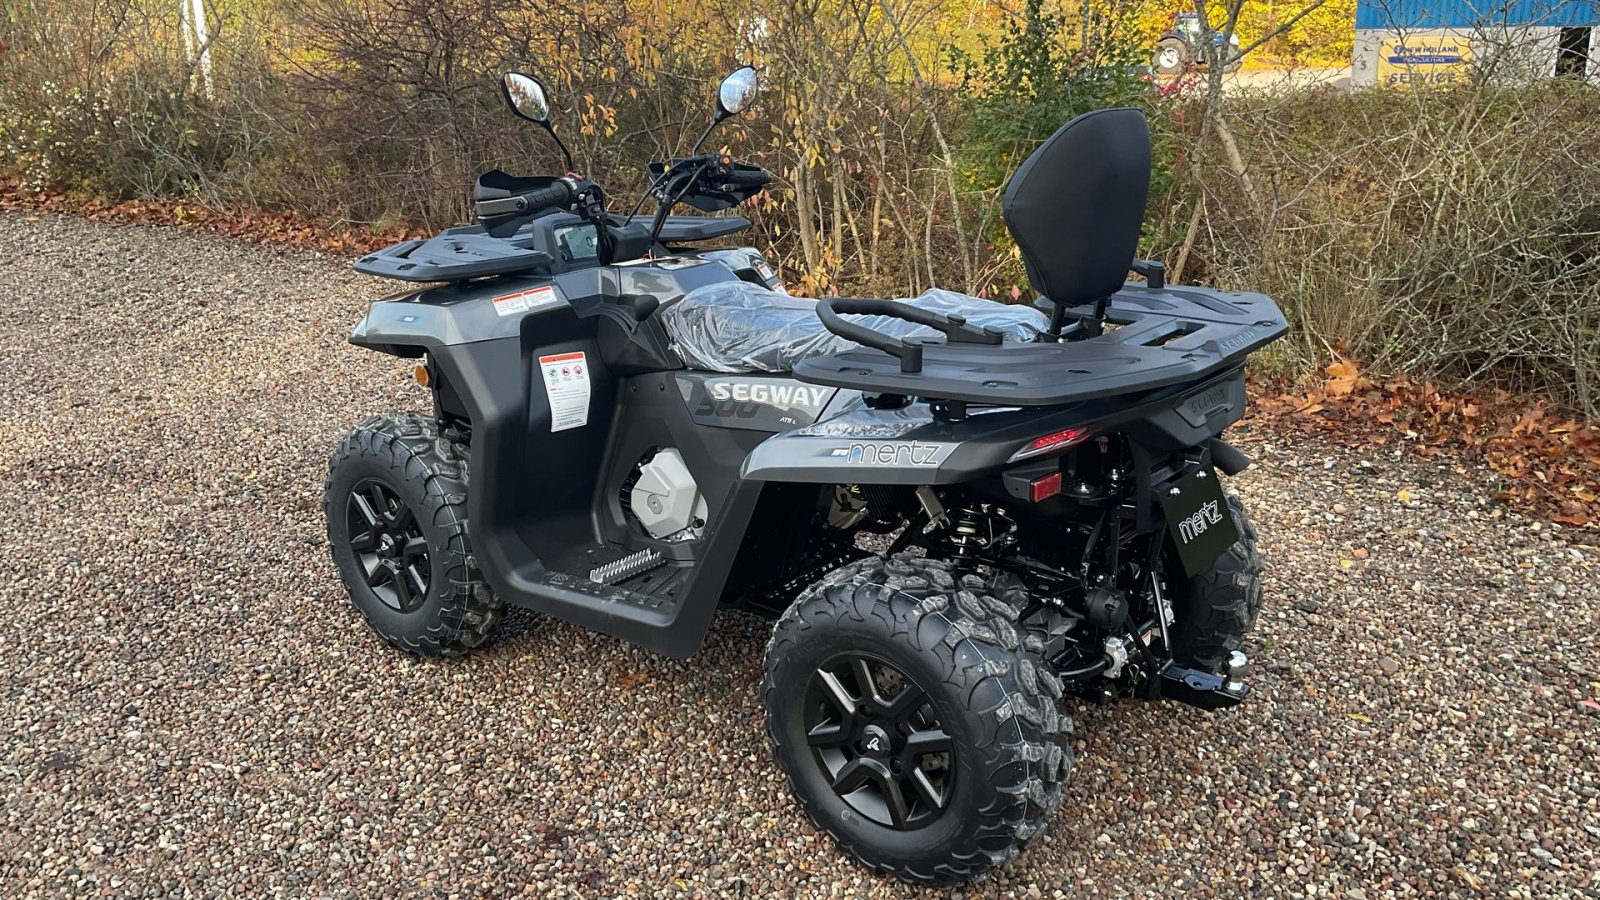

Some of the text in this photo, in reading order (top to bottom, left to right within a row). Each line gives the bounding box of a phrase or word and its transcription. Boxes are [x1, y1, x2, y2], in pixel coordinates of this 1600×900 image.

[1390, 73, 1456, 83] SERVICE
[713, 382, 828, 407] SEGWAY
[847, 440, 942, 466] mertz
[1178, 499, 1223, 544] mertz
